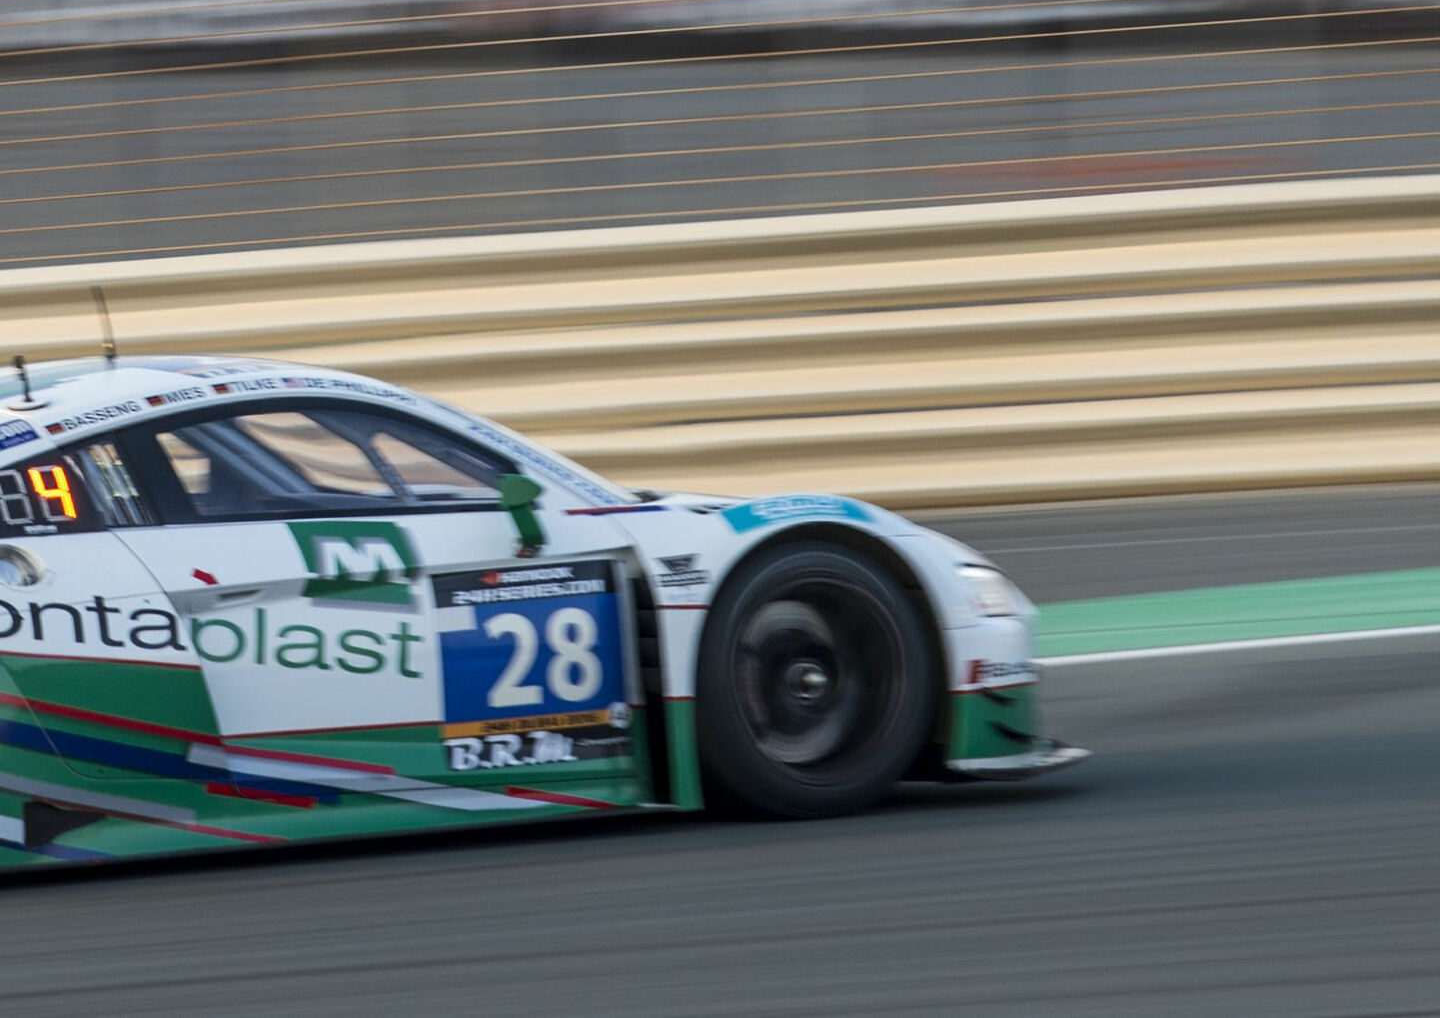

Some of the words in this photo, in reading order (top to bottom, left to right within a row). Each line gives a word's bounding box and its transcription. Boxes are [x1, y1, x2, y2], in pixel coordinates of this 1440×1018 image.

[63, 400, 142, 430] BASSENG
[165, 387, 208, 403] MIES
[230, 378, 277, 392] TILKE
[27, 465, 78, 519] 4
[483, 607, 604, 708] 28
